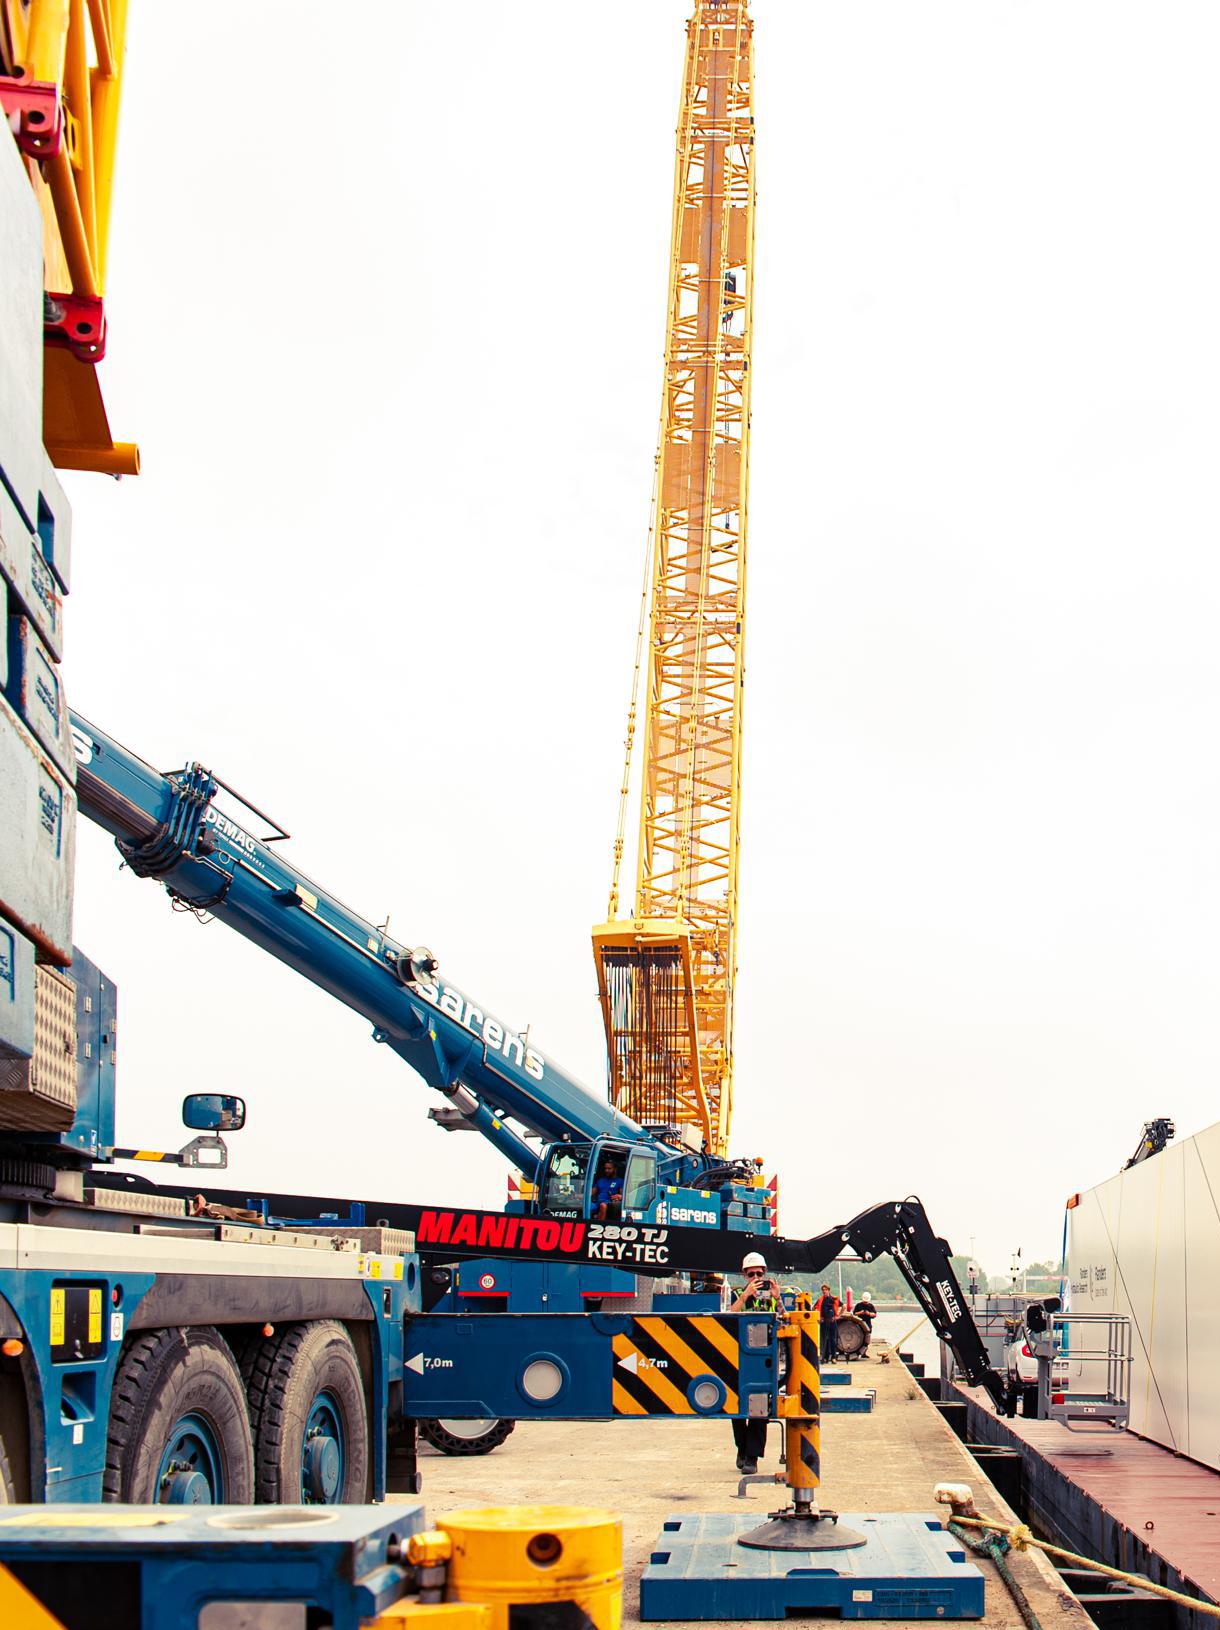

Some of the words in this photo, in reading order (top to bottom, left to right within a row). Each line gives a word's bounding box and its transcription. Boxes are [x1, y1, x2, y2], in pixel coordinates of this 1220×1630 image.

[670, 1207, 717, 1225] sarens
[416, 1210, 586, 1253] MANITOU
[587, 1224, 638, 1241] 280
[642, 1229, 669, 1244] TJ
[587, 1240, 669, 1264] KEY-TEC
[941, 1280, 962, 1319] KEY-TEC
[424, 1357, 453, 1369] 7,0m
[638, 1357, 668, 1369] 4,7m
